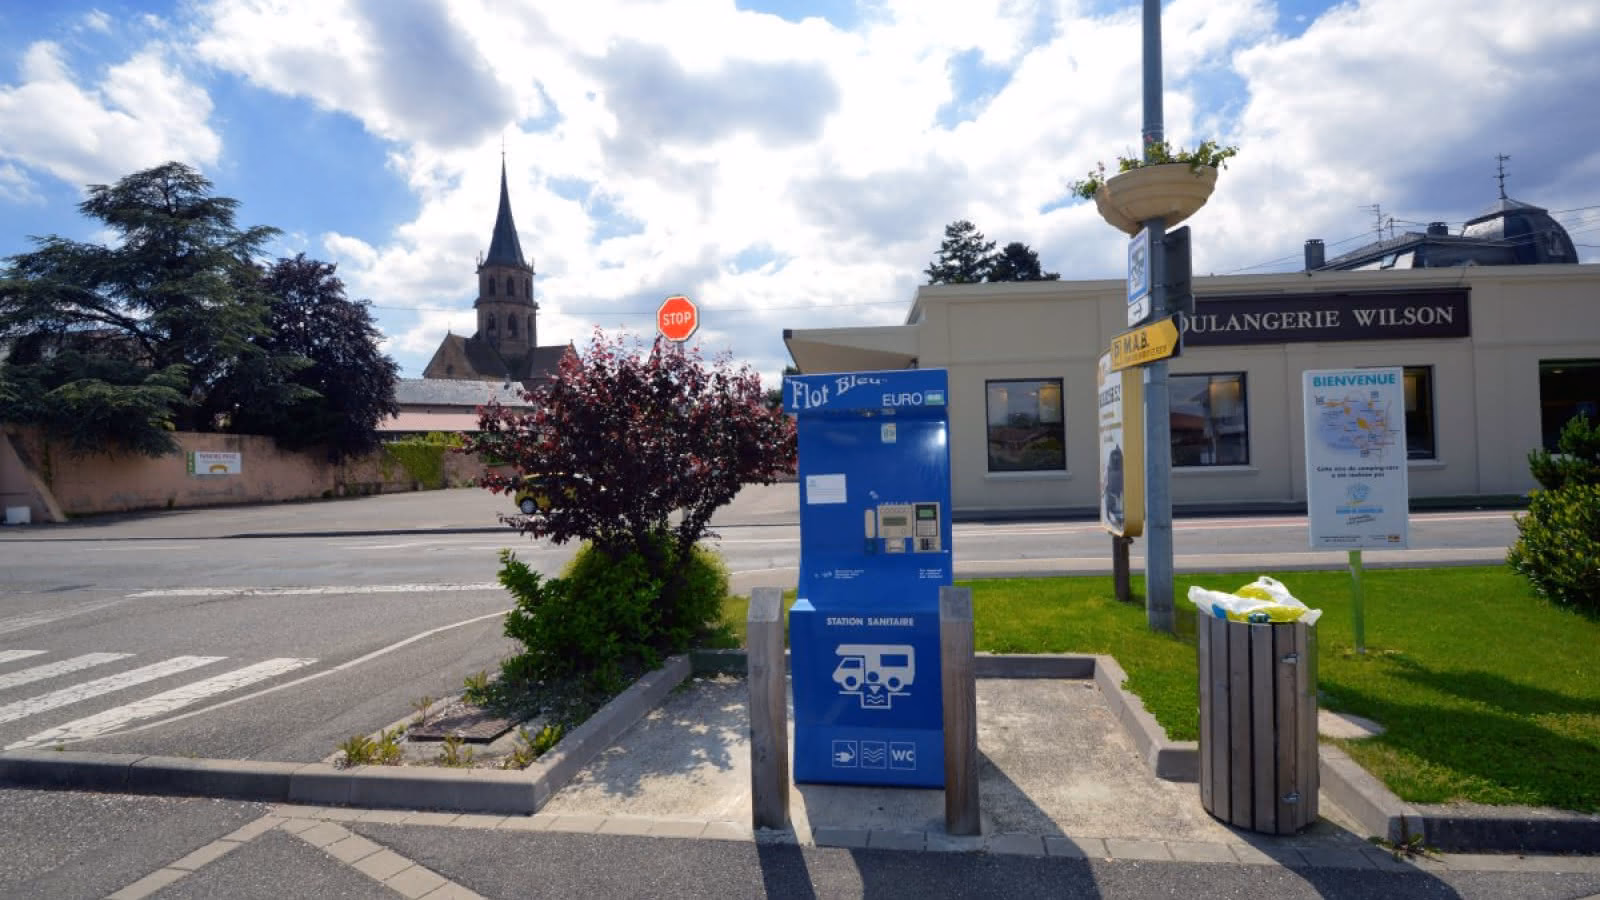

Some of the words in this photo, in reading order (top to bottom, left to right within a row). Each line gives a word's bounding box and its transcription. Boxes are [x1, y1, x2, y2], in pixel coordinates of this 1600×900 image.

[663, 311, 692, 326] STOP
[1351, 305, 1454, 327] WILSON
[1312, 373, 1396, 387] BIENVENUE
[882, 391, 923, 407] EURO
[826, 617, 864, 626] STATION
[867, 617, 915, 627] SANITAIRE
[891, 750, 914, 762] WC
